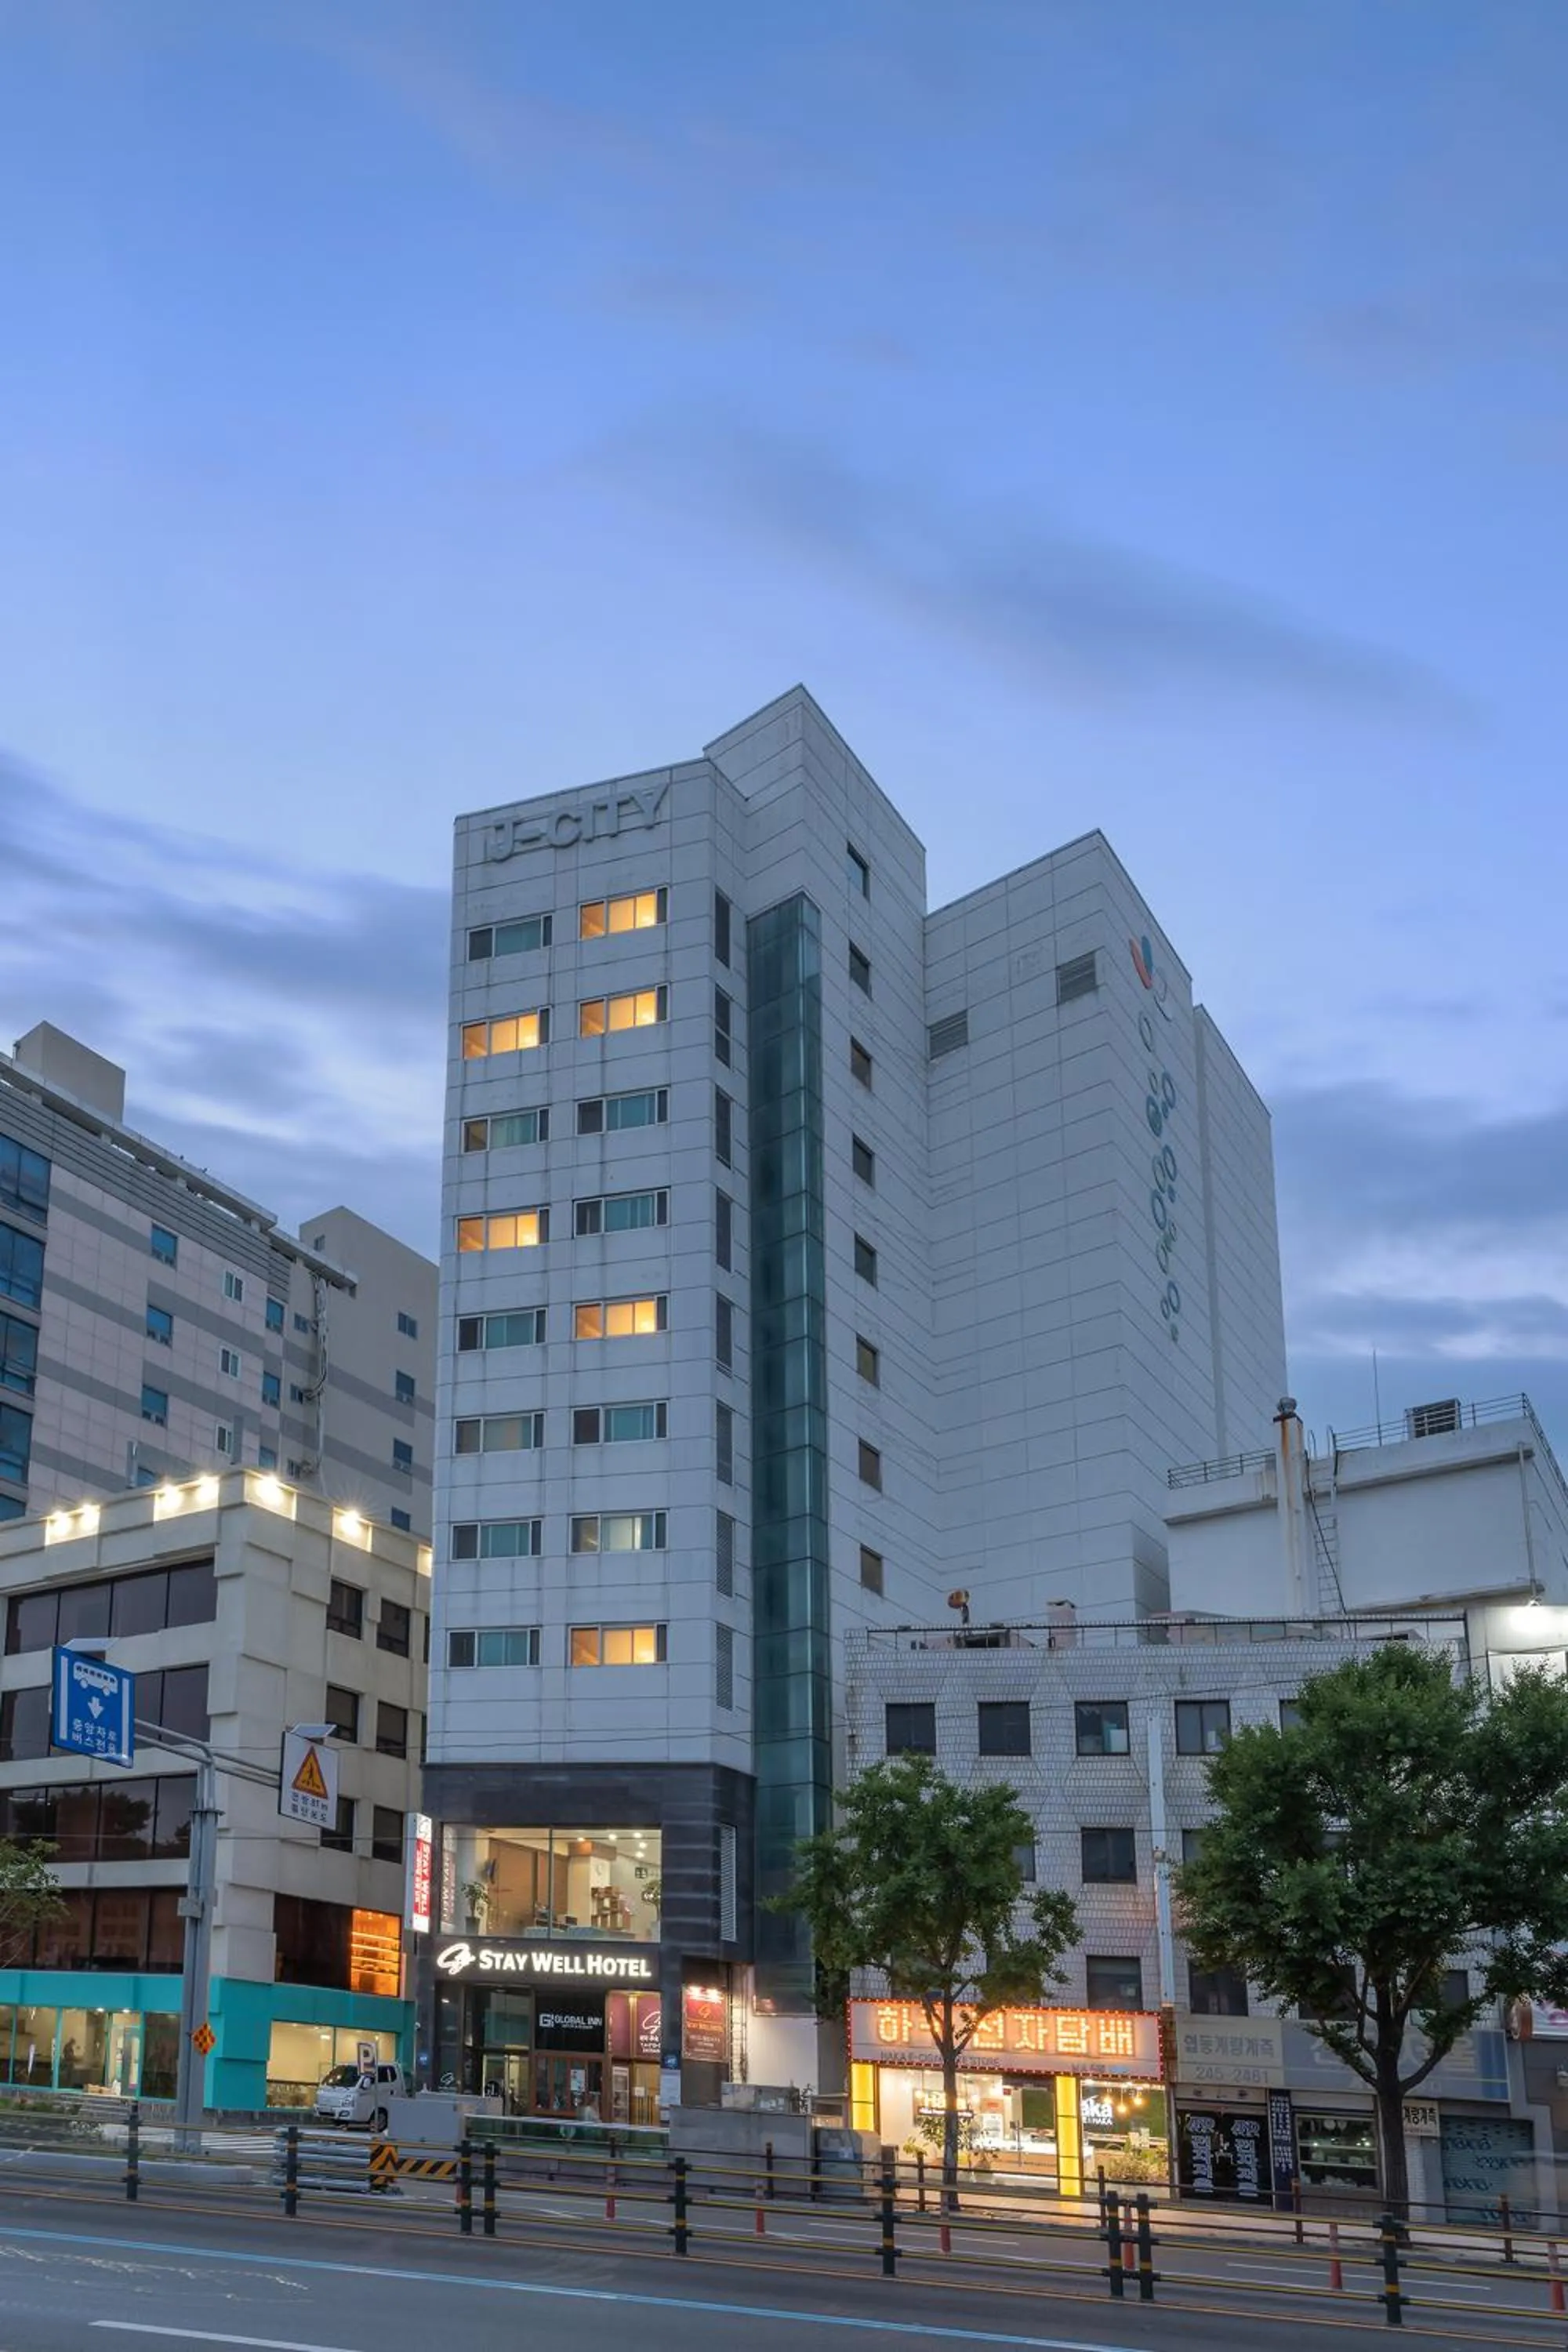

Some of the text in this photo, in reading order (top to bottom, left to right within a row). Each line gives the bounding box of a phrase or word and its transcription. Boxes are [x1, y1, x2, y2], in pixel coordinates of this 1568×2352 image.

[419, 1843, 430, 1914] STAY WELL
[478, 1949, 652, 1977] STAY WELL HOTEL
[554, 2014, 603, 2027] GLOBAL INN
